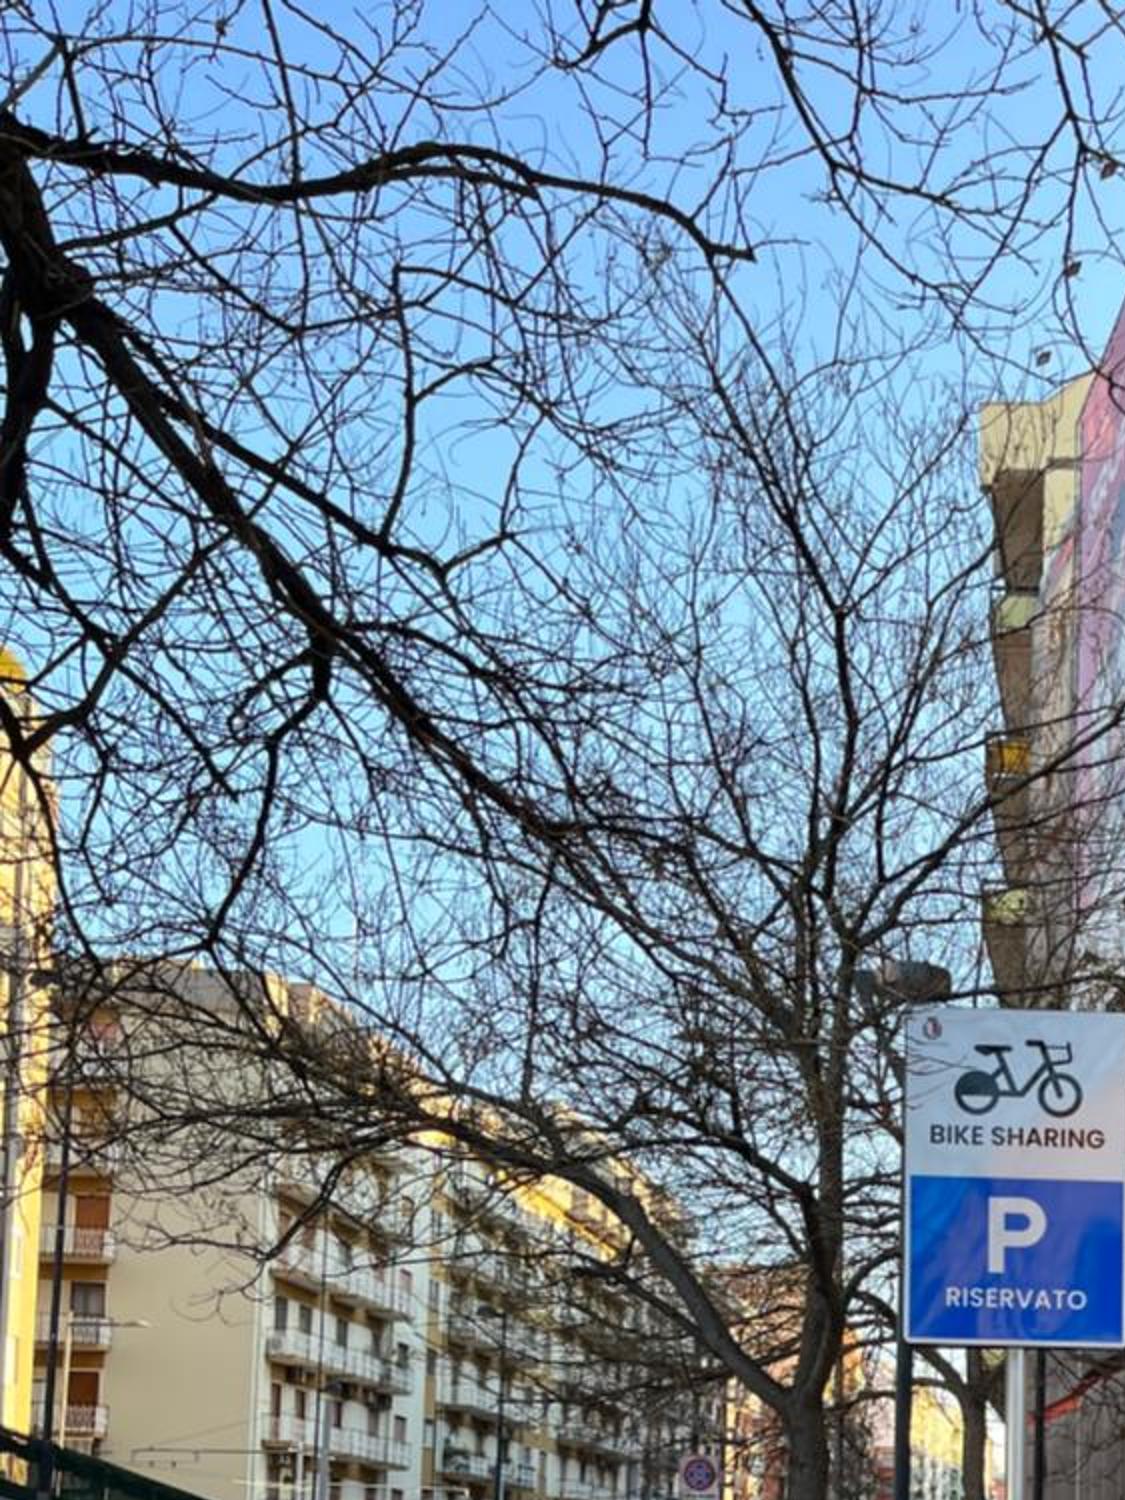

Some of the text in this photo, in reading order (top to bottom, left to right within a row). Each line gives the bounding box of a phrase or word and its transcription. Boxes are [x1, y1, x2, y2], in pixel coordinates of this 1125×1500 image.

[930, 1124, 1106, 1149] BIKE SHARING
[986, 1196, 1047, 1275] P
[945, 1287, 1088, 1310] RISERVATO
